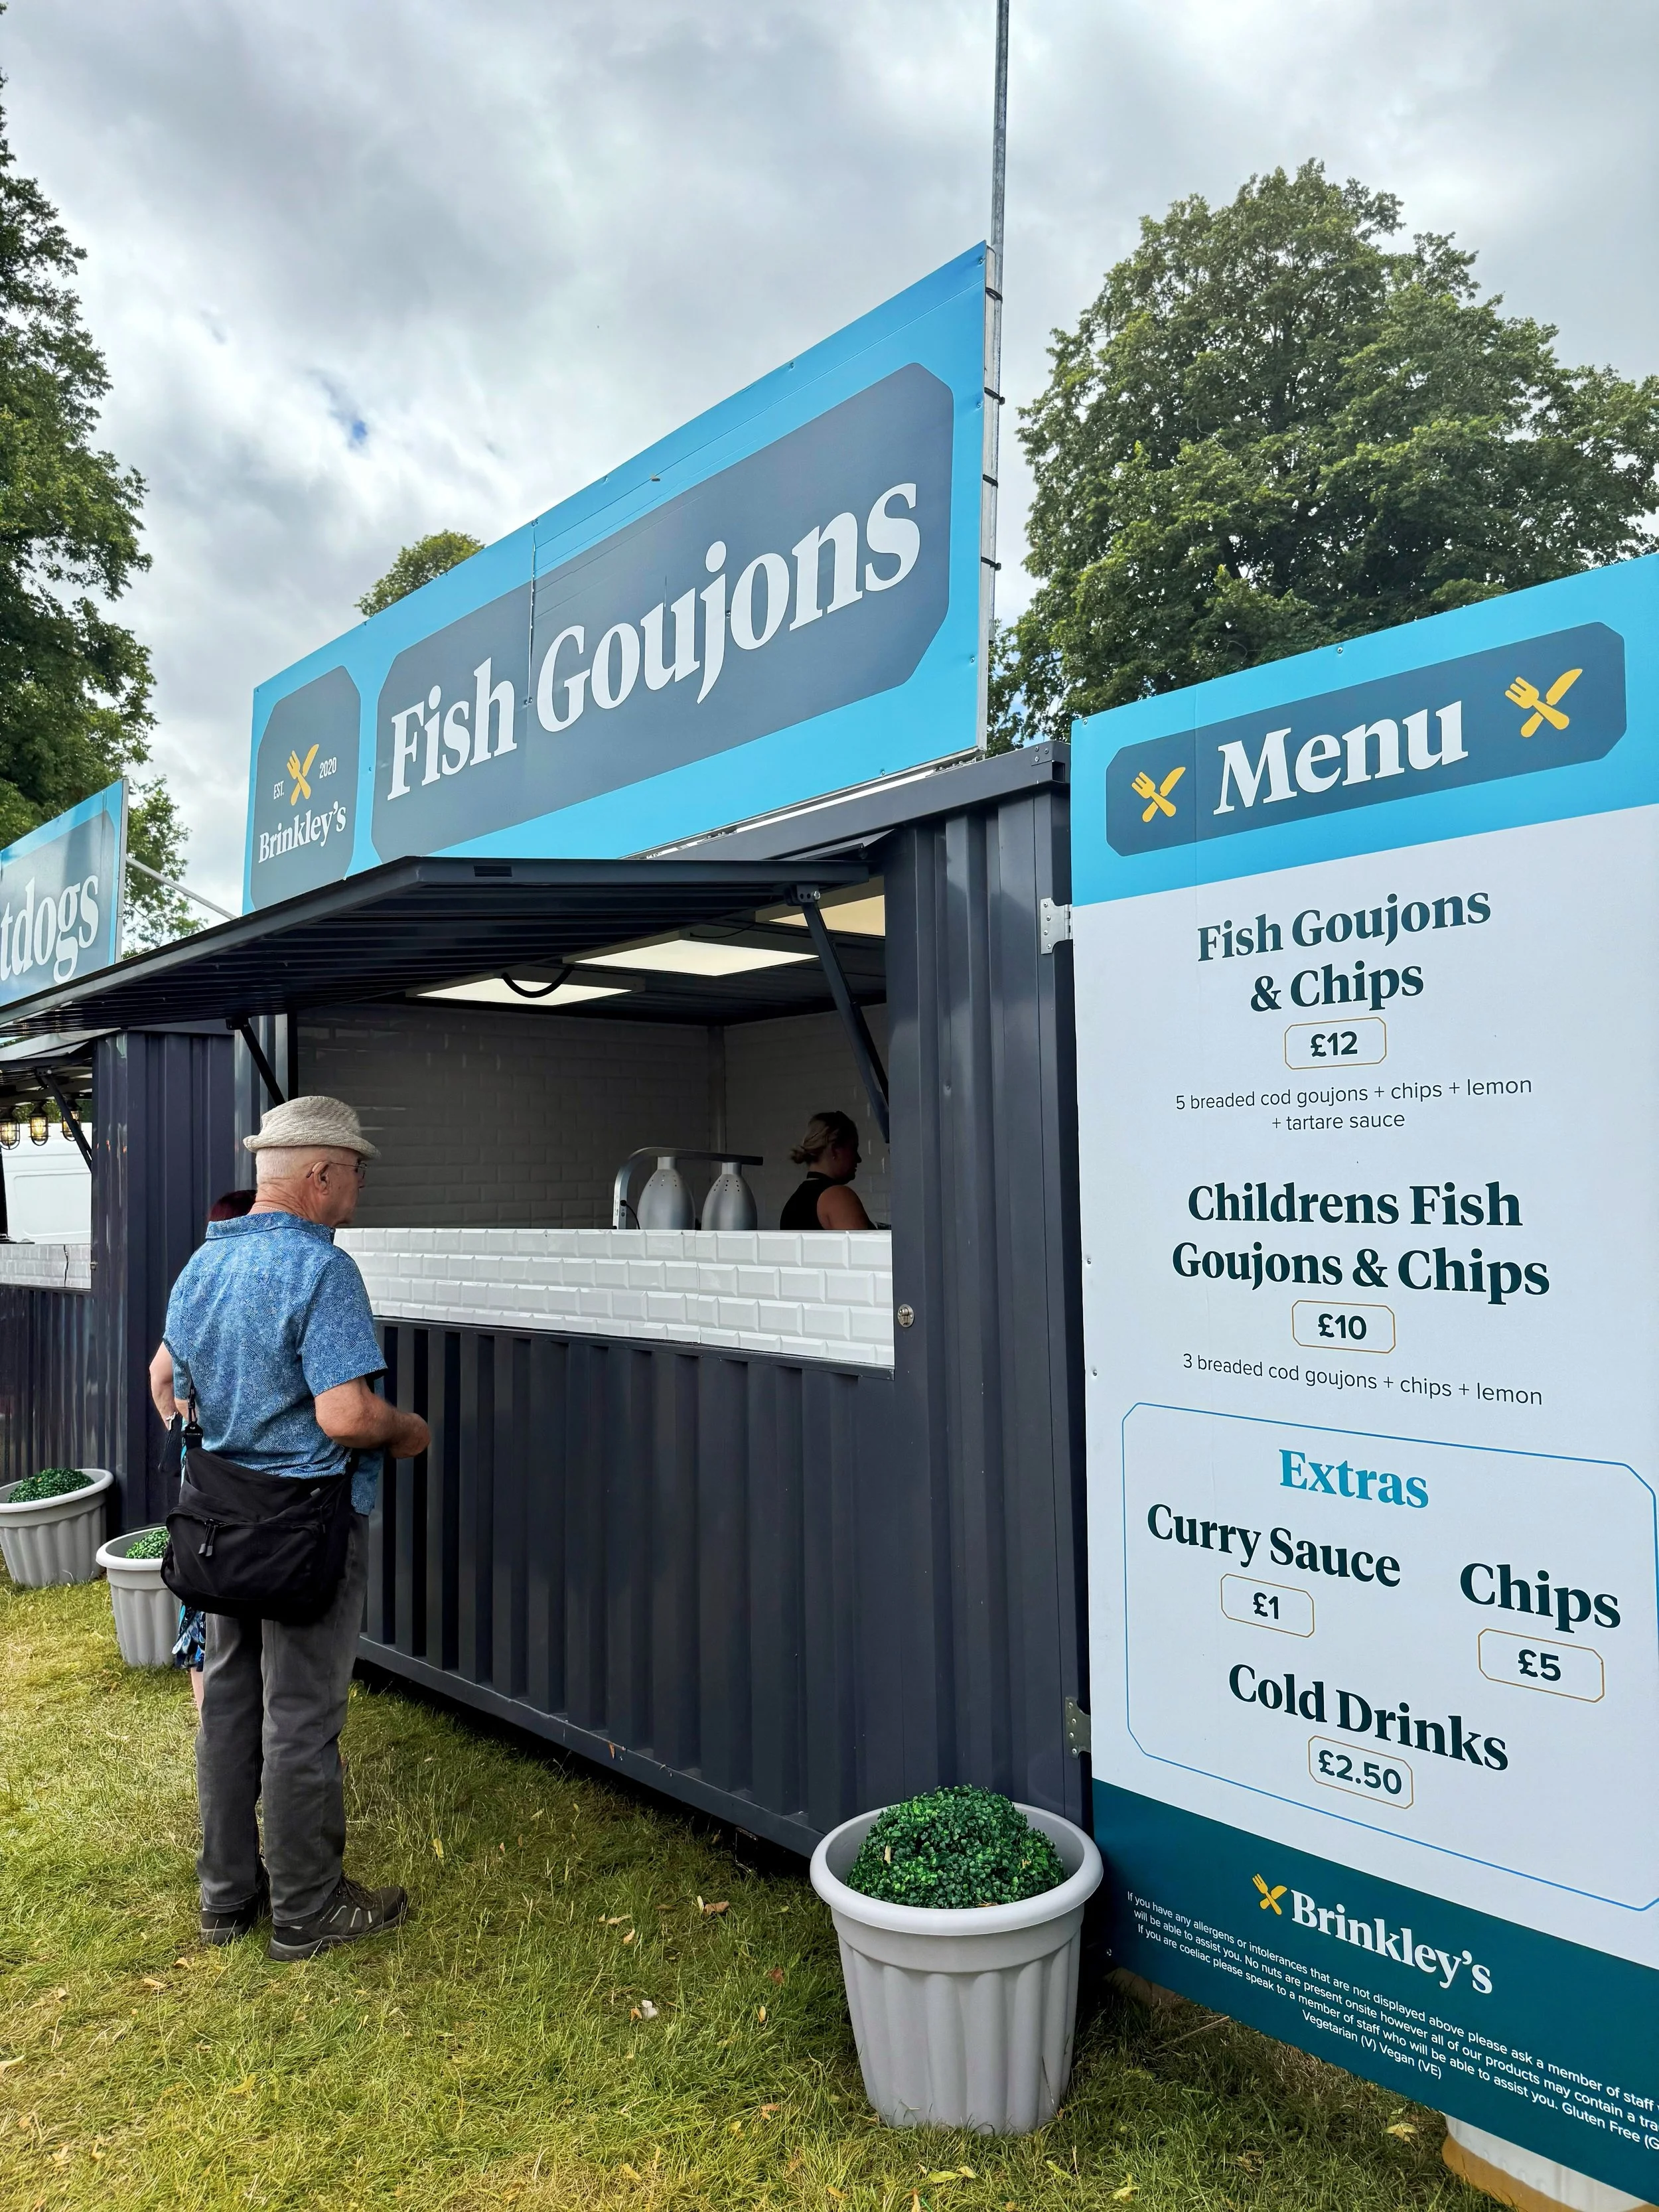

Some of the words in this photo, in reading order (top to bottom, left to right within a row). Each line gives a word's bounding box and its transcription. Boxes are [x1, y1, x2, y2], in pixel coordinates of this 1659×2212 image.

[387, 657, 518, 801] Fish
[537, 482, 921, 733] Goujons
[273, 780, 284, 800] EST.
[319, 757, 337, 779] 2020
[1214, 701, 1468, 815] Menu
[258, 800, 346, 863] Brinkley's
[1197, 913, 1284, 962] Fish
[1292, 892, 1491, 947] Goujons
[1250, 976, 1282, 1012] &
[1290, 960, 1424, 1011] Chips
[1310, 1031, 1358, 1057] £12
[1176, 1095, 1185, 1110] 5
[1190, 1090, 1255, 1109] breaded
[1261, 1088, 1291, 1106] cod
[1297, 1086, 1368, 1108] goujons
[1374, 1086, 1385, 1098] +
[1391, 1082, 1443, 1102] chips
[1449, 1082, 1461, 1094] +
[1467, 1078, 1532, 1096] lemon
[1271, 1118, 1281, 1129] +
[1285, 1115, 1343, 1131] tartare
[1350, 1114, 1406, 1128] sauce
[1188, 1181, 1400, 1224] Childrens
[1409, 1181, 1524, 1226] Fish
[1173, 1241, 1343, 1291] Goujons
[1352, 1248, 1389, 1288] &
[1398, 1246, 1550, 1305] Chips
[1317, 1313, 1367, 1340] £10
[1183, 1353, 1192, 1368] 3
[1198, 1355, 1263, 1376] breaded
[1268, 1364, 1299, 1381] cod
[1305, 1370, 1377, 1390] goujons
[1383, 1376, 1394, 1388] +
[1400, 1376, 1452, 1399] chips
[1458, 1383, 1470, 1396] +
[1477, 1382, 1542, 1406] lemon
[1279, 1449, 1429, 1509] Extras
[1147, 1504, 1262, 1568] Curry
[1269, 1527, 1401, 1587] Sauce
[1252, 1591, 1279, 1620] £1
[1460, 1563, 1621, 1634] Chips
[1518, 1649, 1561, 1682] £5
[1229, 1664, 1328, 1723] Cold
[1335, 1689, 1508, 1773] Drinks
[1318, 1748, 1402, 1795] £2.50
[1291, 1889, 1493, 1994] Brinkley's
[1127, 1891, 1133, 1901] If
[1135, 1896, 1151, 1909] you
[1152, 1901, 1173, 1918] have
[1175, 1913, 1191, 1927] any
[1193, 1921, 1235, 1944] allergens
[1237, 1939, 1247, 1949] or
[1249, 1944, 1308, 1974] intolerances
[1310, 1967, 1331, 1984] that
[1333, 1978, 1350, 1992] are
[1353, 1986, 1370, 2000] not
[1373, 1994, 1425, 2022] displayed
[1429, 2016, 1465, 2037] above
[1468, 2031, 1508, 2055] please
[1511, 2049, 1533, 2065] ask
[1536, 2059, 1544, 2069] a
[1548, 2063, 1603, 2092] member
[1606, 2086, 1621, 2099] of
[1623, 2093, 1654, 2112] staff
[1133, 1910, 1147, 1922] will
[1150, 1915, 1161, 1927] be
[1163, 1923, 1182, 1936] able
[1184, 1930, 1193, 1941] to
[1195, 1936, 1221, 1953] assist
[1222, 1947, 1240, 1961] you.
[1245, 1954, 1259, 1969] No
[1262, 1964, 1283, 1979] nuts
[1285, 1974, 1301, 1987] are
[1303, 1982, 1343, 2005] present
[1345, 1999, 1378, 2018] onsite
[1380, 2010, 1428, 2039] however
[1431, 2033, 1444, 2046] all
[1447, 2041, 1459, 2052] of
[1462, 2047, 1482, 2061] our
[1485, 2055, 1540, 2085] products
[1544, 2079, 1571, 2099] may
[1574, 2091, 1623, 2118] contain
[1626, 2112, 1636, 2123] a
[1639, 2114, 1659, 2132] tra
[1138, 1923, 1143, 1934] If
[1145, 1929, 1161, 1942] you
[1163, 1937, 1177, 1949] are
[1179, 1944, 1210, 1963] coeliac
[1213, 1958, 1243, 1977] please
[1245, 1972, 1274, 1991] speak
[1276, 1984, 1287, 1996] to
[1289, 1991, 1295, 2000] a
[1298, 1995, 1340, 2019] member
[1343, 2014, 1354, 2025] of
[1356, 2020, 1380, 2035] staff
[1382, 2029, 1407, 2046] who
[1409, 2041, 1428, 2056] will
[1431, 2047, 1447, 2063] be
[1449, 2058, 1475, 2075] able
[1477, 2067, 1490, 2081] to
[1493, 2076, 1529, 2098] assist
[1531, 2091, 1558, 2110] you.
[1561, 2102, 1605, 2129] Gluten
[1609, 2120, 1640, 2142] Free
[1302, 2009, 1358, 2042] Vegetarian
[1361, 2035, 1376, 2052] (V)
[1379, 2041, 1415, 2067] Vegan
[1418, 2059, 1441, 2080] (VE)
